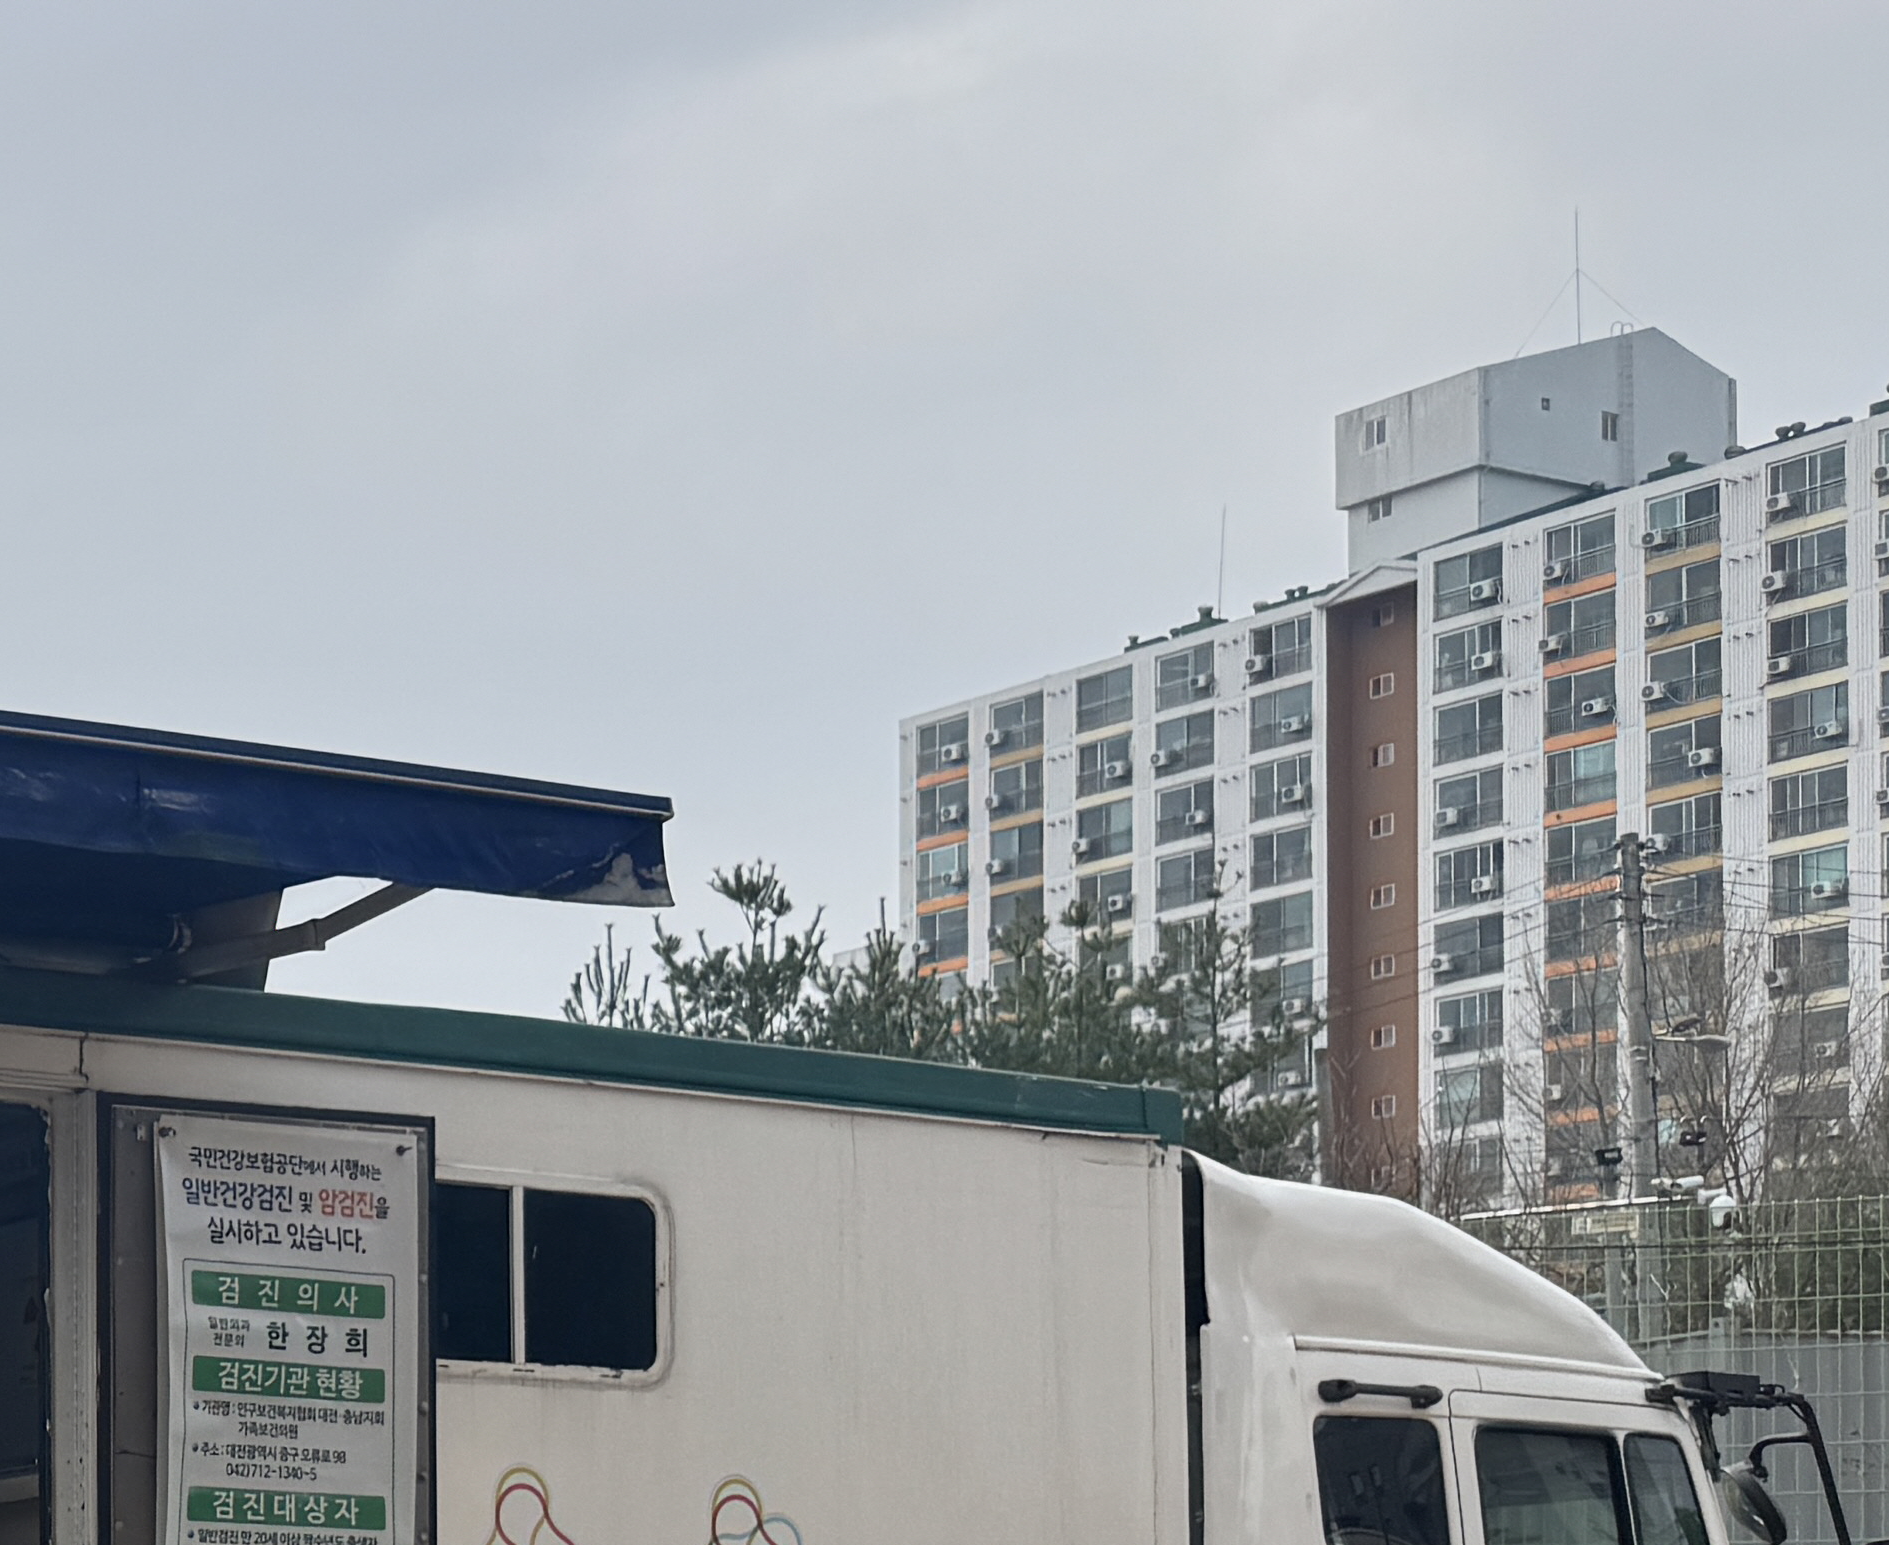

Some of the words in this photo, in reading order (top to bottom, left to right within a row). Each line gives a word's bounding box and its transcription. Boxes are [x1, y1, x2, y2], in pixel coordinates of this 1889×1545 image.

[188, 1146, 326, 1176] 국민건강보험공단에서
[331, 1158, 382, 1182] 시행하는
[182, 1177, 293, 1213] 일반건강검진
[299, 1191, 313, 1214] 및
[318, 1188, 390, 1220] 암검진을
[207, 1216, 282, 1245] 실시하고
[287, 1223, 367, 1254] 있습니다.
[213, 1333, 245, 1348] 전문의
[218, 1361, 311, 1395] 검진기관
[316, 1368, 363, 1399] 현황
